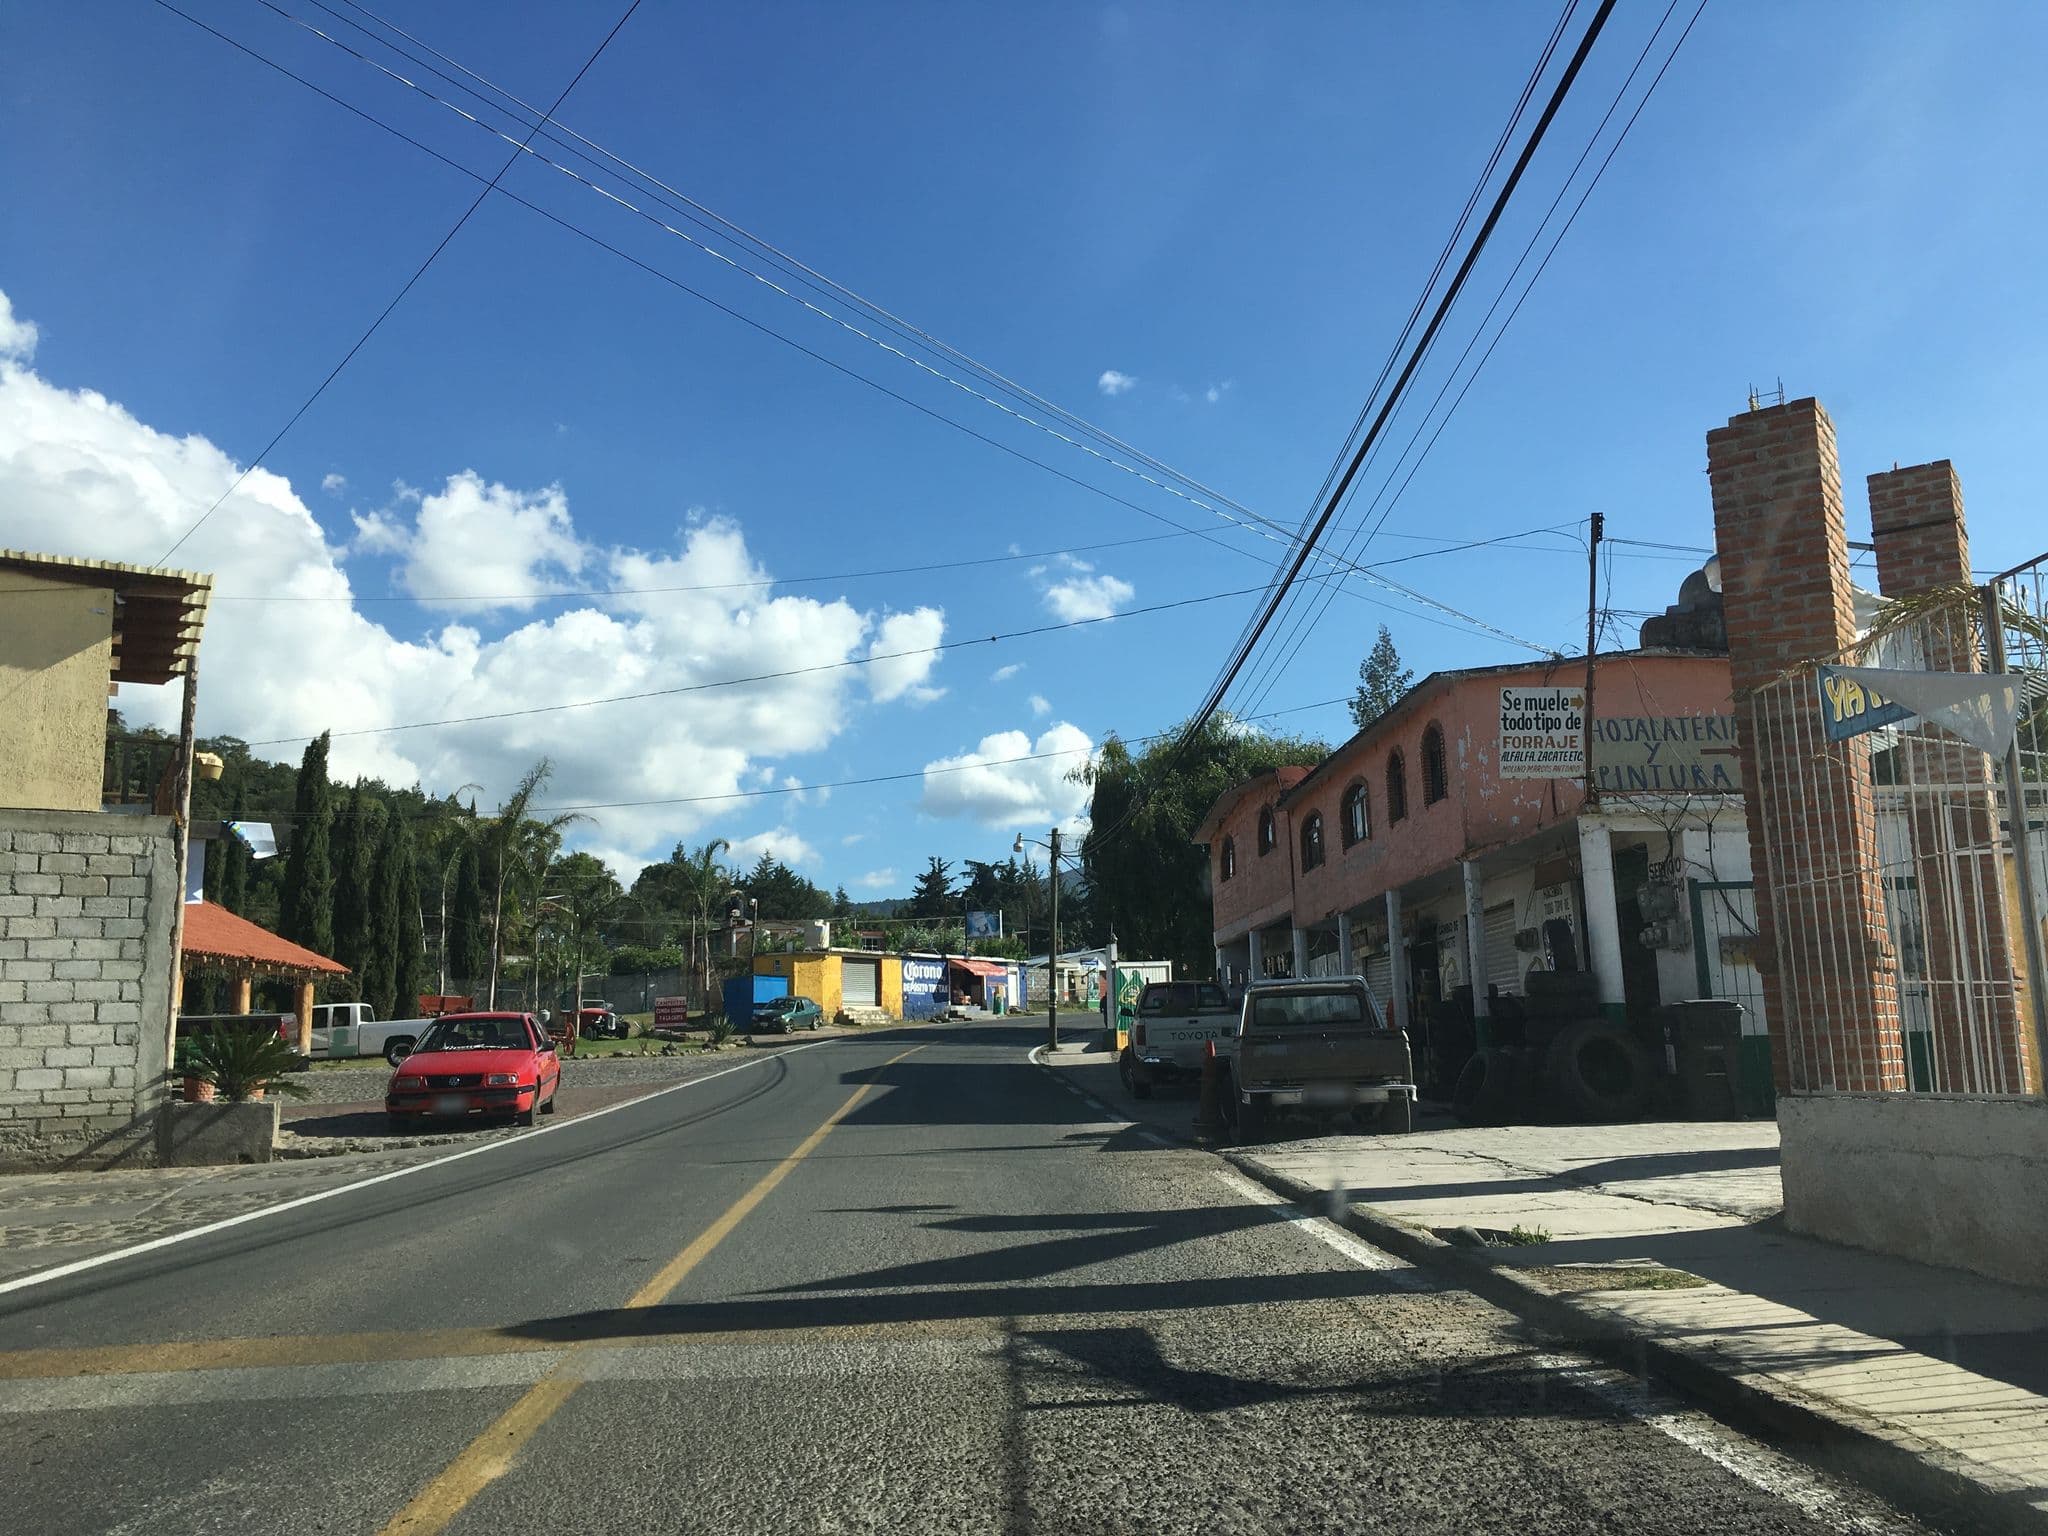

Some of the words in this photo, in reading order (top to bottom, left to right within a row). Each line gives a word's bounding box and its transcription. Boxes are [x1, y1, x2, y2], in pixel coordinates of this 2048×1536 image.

[1502, 690, 1521, 711] Se
[1525, 690, 1569, 711] muele
[1501, 712, 1532, 730] todo
[1534, 712, 1561, 733] tipo
[1566, 712, 1581, 730] de
[1503, 736, 1578, 749] FORRAJE
[1643, 742, 1661, 764] Y
[1538, 751, 1568, 761] ZACATE
[1599, 763, 1732, 790] PINTURA
[904, 961, 945, 983] Corona
[1170, 1031, 1218, 1041] TOYOTA
